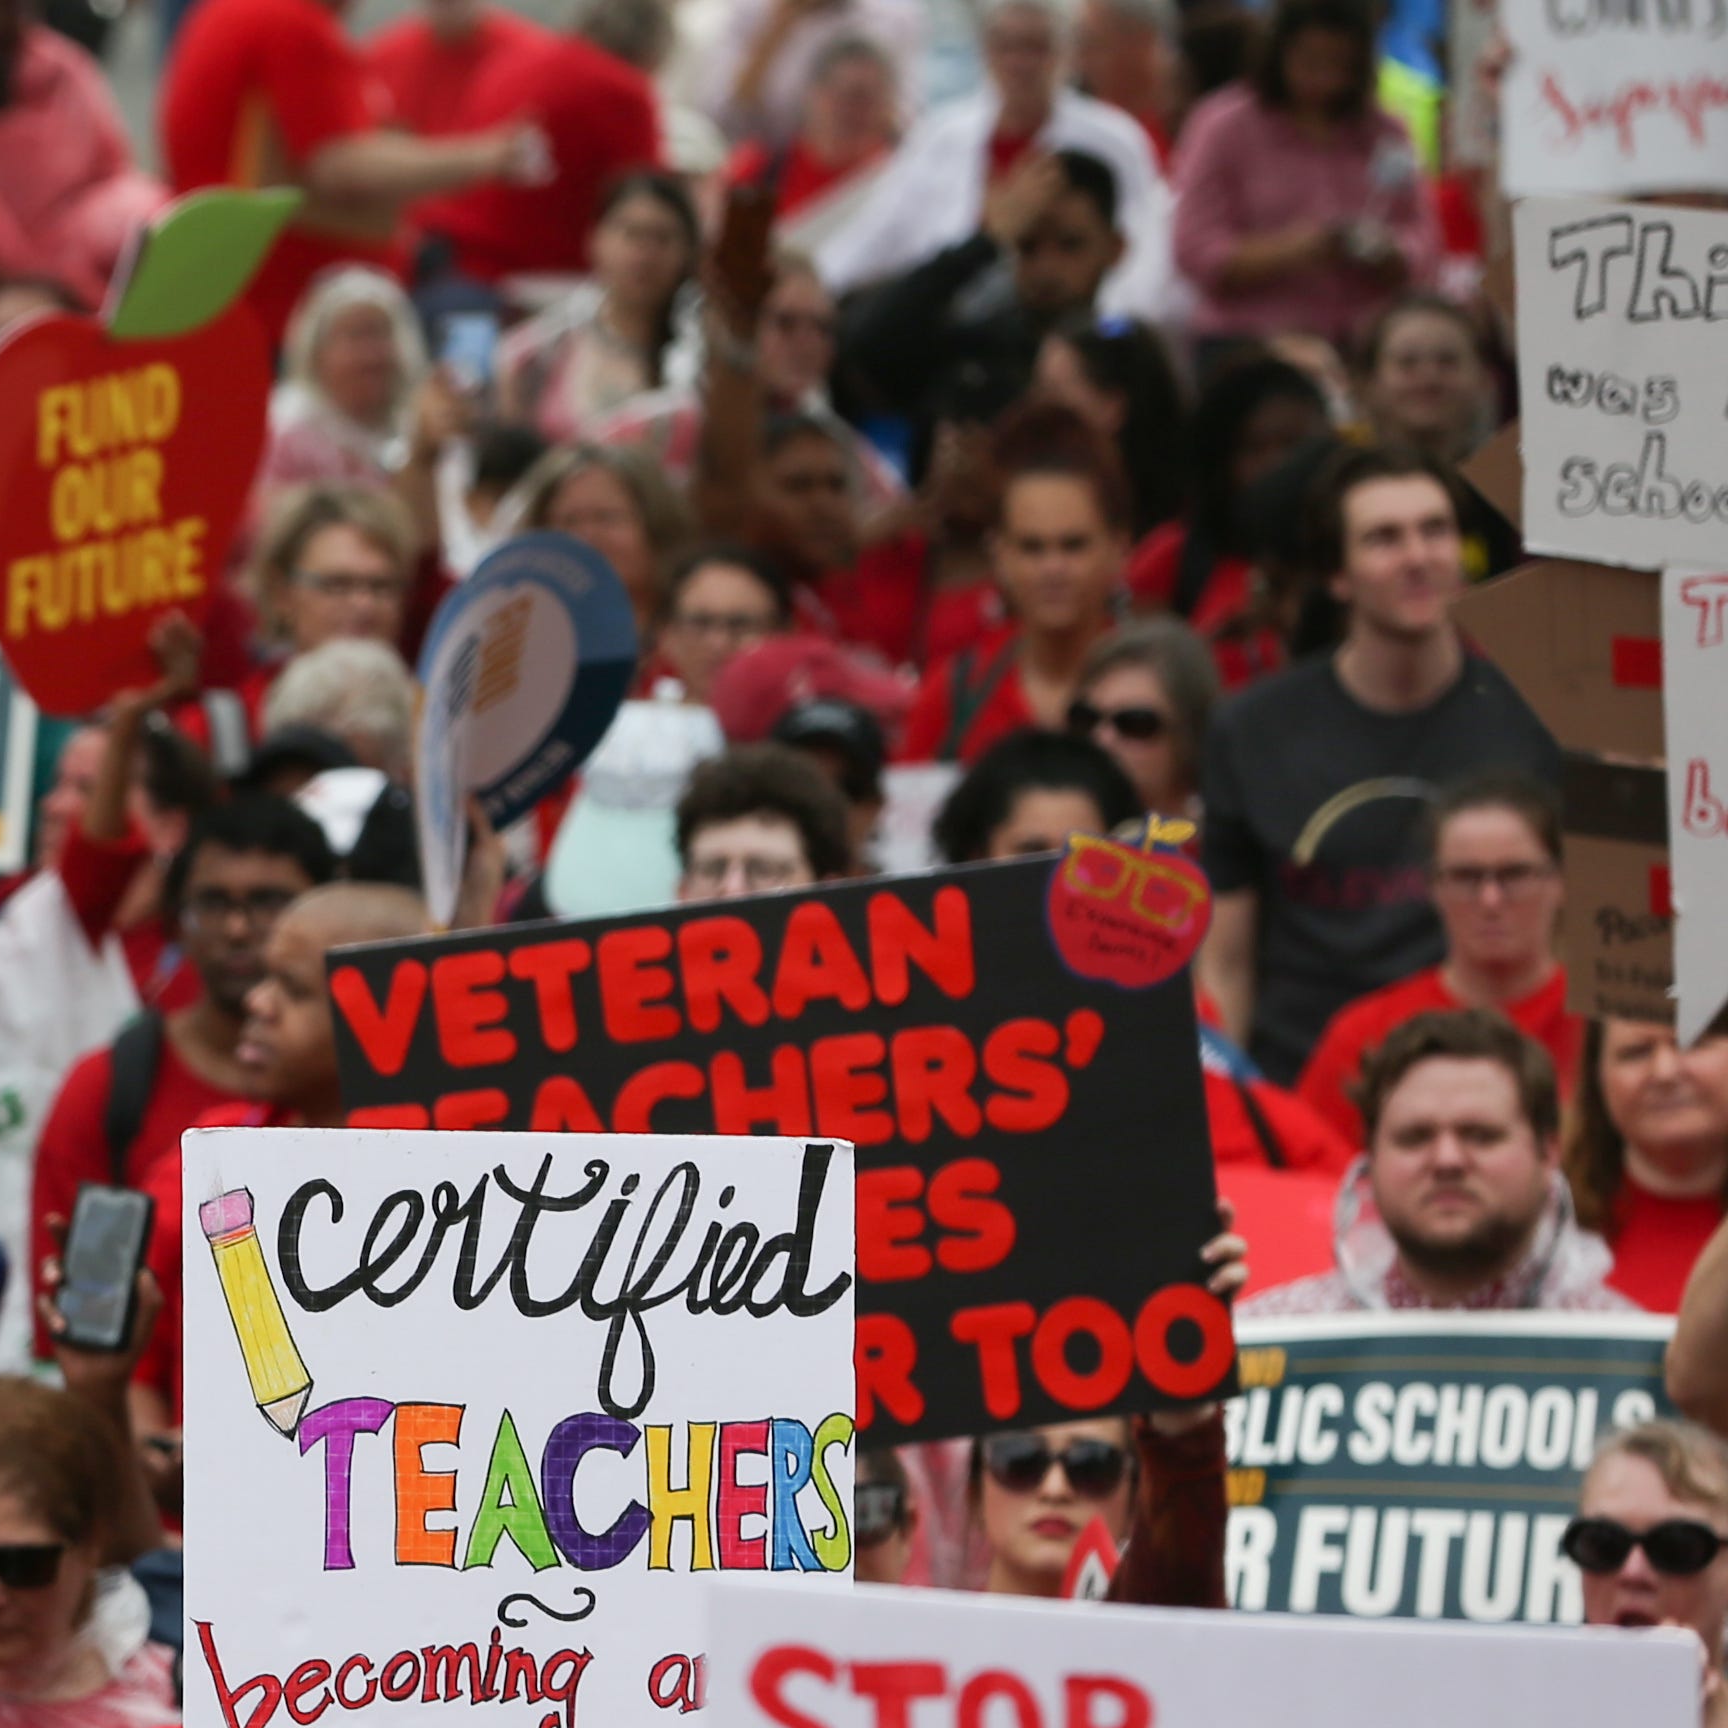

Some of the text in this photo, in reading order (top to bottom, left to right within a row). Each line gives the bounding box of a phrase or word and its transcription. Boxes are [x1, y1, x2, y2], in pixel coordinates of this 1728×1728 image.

[36, 362, 181, 467] FUND
[50, 448, 165, 538] OUR
[5, 516, 208, 637] FUTURE
[330, 884, 977, 1077] VETERAN
[348, 1006, 1106, 1146] ACHERS'
[277, 1143, 850, 1420] certified
[951, 1282, 1237, 1415] TOO
[298, 1396, 856, 1572] TEACHERS
